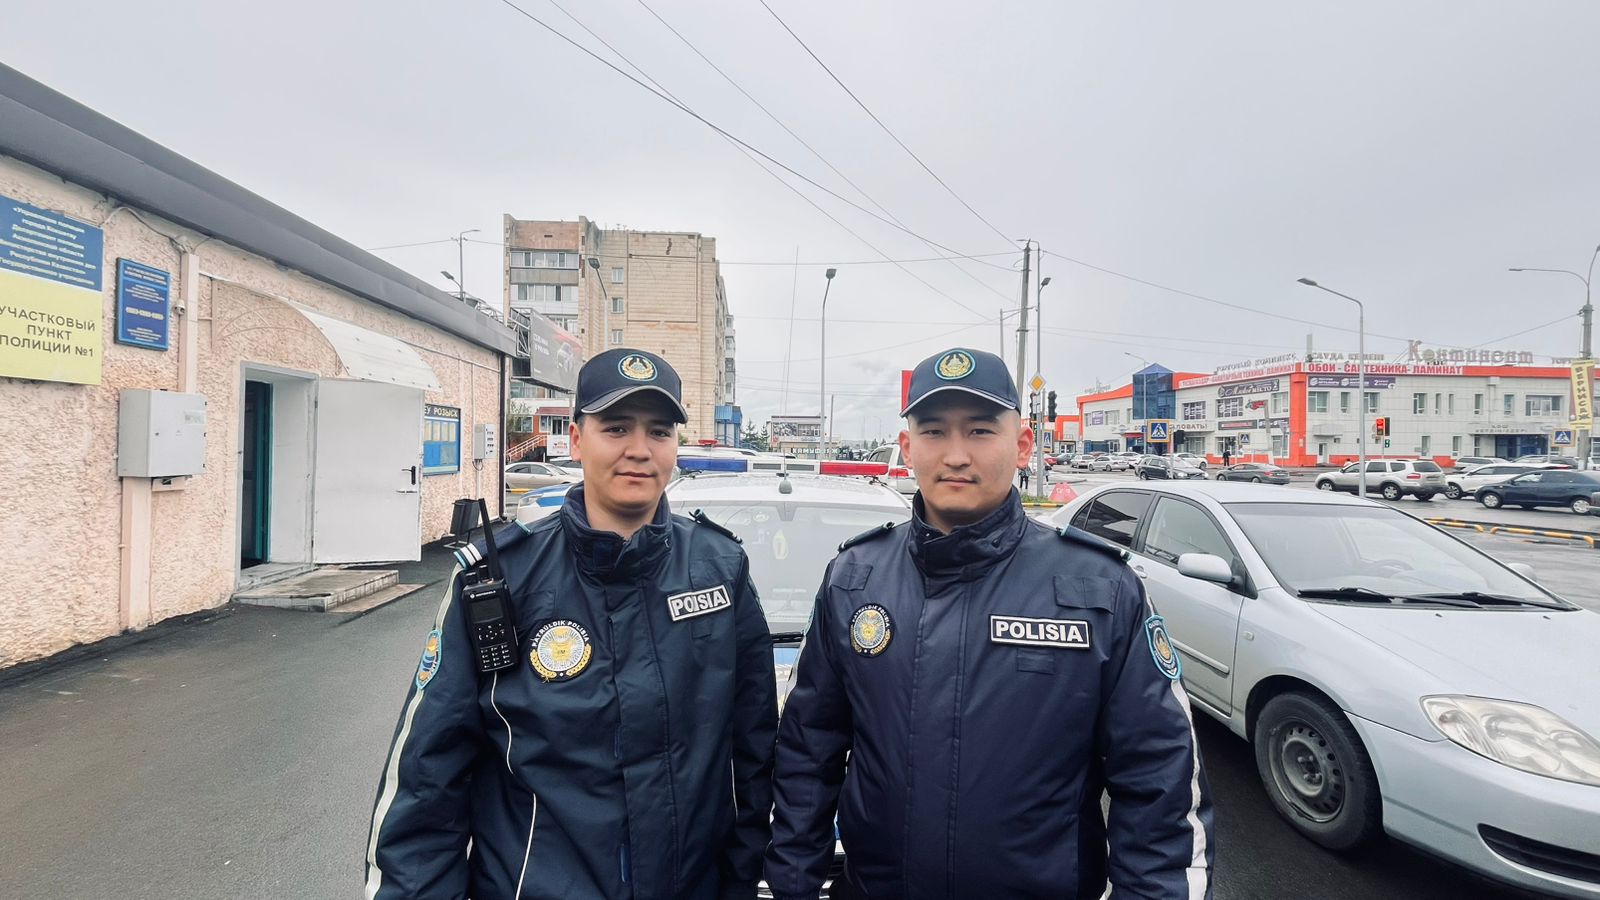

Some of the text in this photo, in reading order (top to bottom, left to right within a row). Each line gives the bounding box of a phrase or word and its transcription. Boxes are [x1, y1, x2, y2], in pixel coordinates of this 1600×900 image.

[0, 305, 96, 331] УЧАСТКОВЫЙ
[27, 324, 72, 340] ПУНКТ
[0, 334, 71, 354] ПОЛИЦИИ
[1308, 363, 1336, 372] ОБОИ
[1412, 365, 1462, 375] ЛАМИНАТ
[996, 620, 1084, 642] POLISIA
